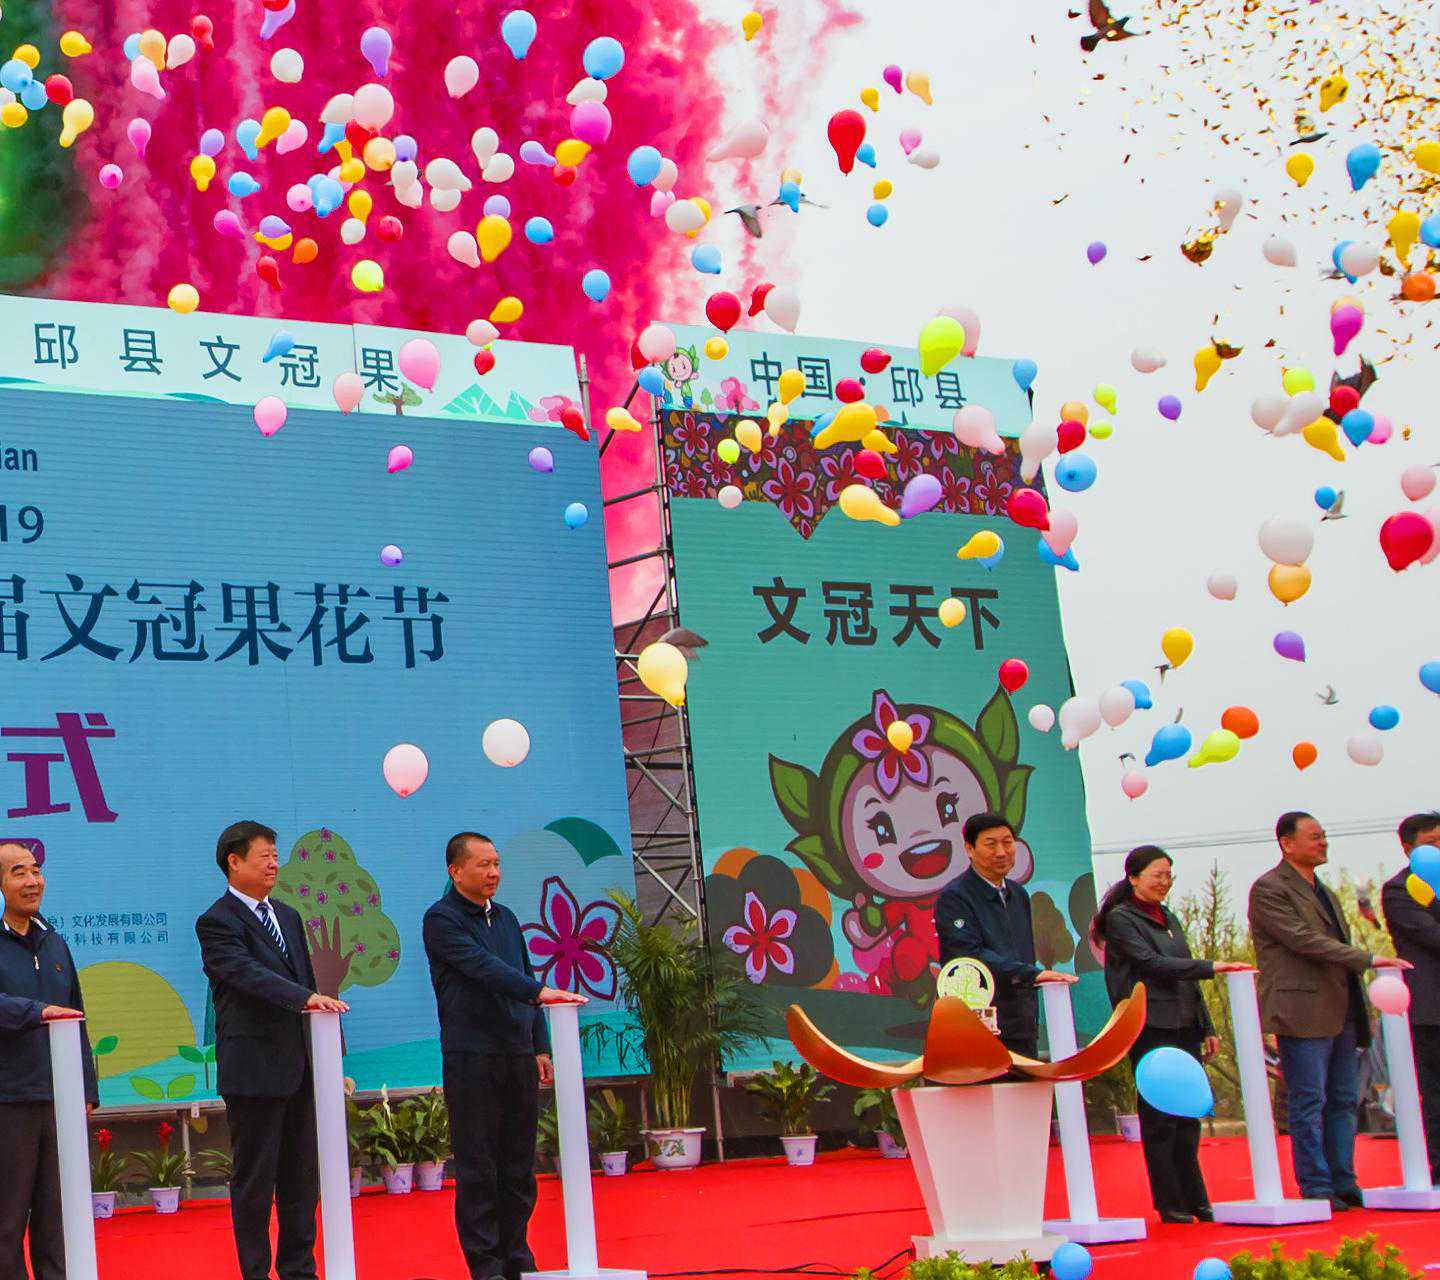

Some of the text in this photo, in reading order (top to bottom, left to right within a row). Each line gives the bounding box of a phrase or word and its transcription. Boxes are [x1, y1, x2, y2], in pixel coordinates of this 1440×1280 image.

[33, 322, 400, 392] 邱县文冠果
[751, 576, 1001, 651] 文冠天下
